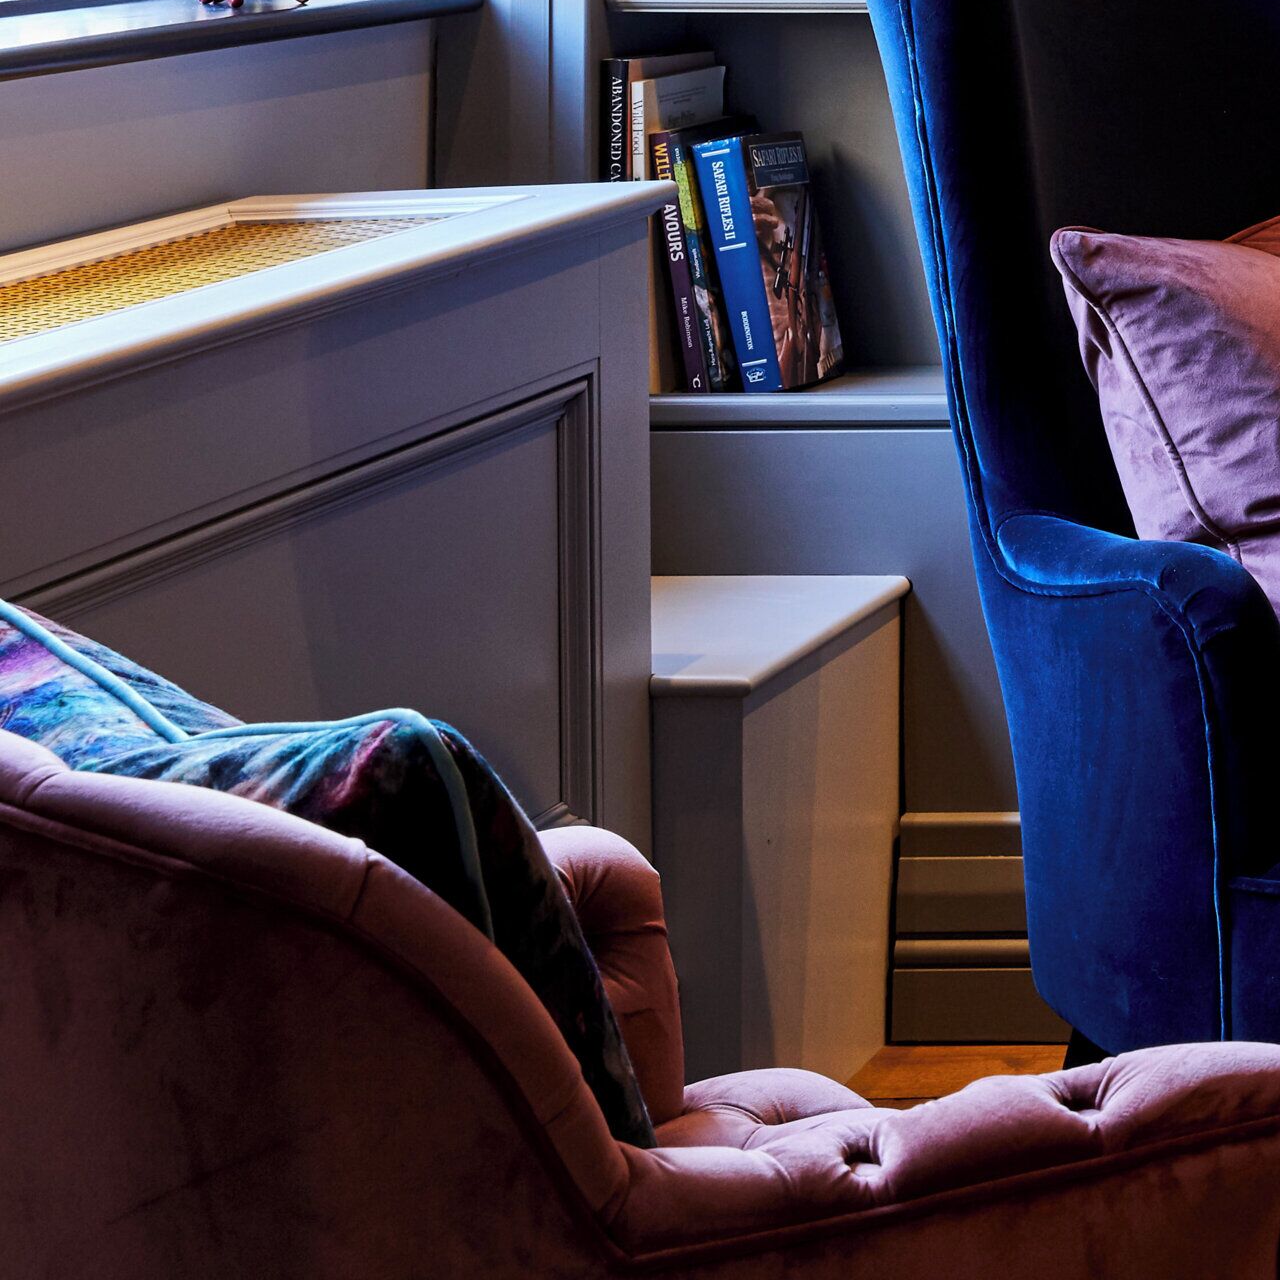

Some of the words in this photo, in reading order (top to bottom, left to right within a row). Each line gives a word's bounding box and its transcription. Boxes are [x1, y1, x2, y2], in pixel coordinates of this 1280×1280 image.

[712, 160, 731, 200] SAFARI
[717, 200, 735, 233] RIFLES
[680, 296, 690, 315] Mike
[684, 317, 693, 348] Robinson
[741, 310, 754, 350] BODDINGTON
